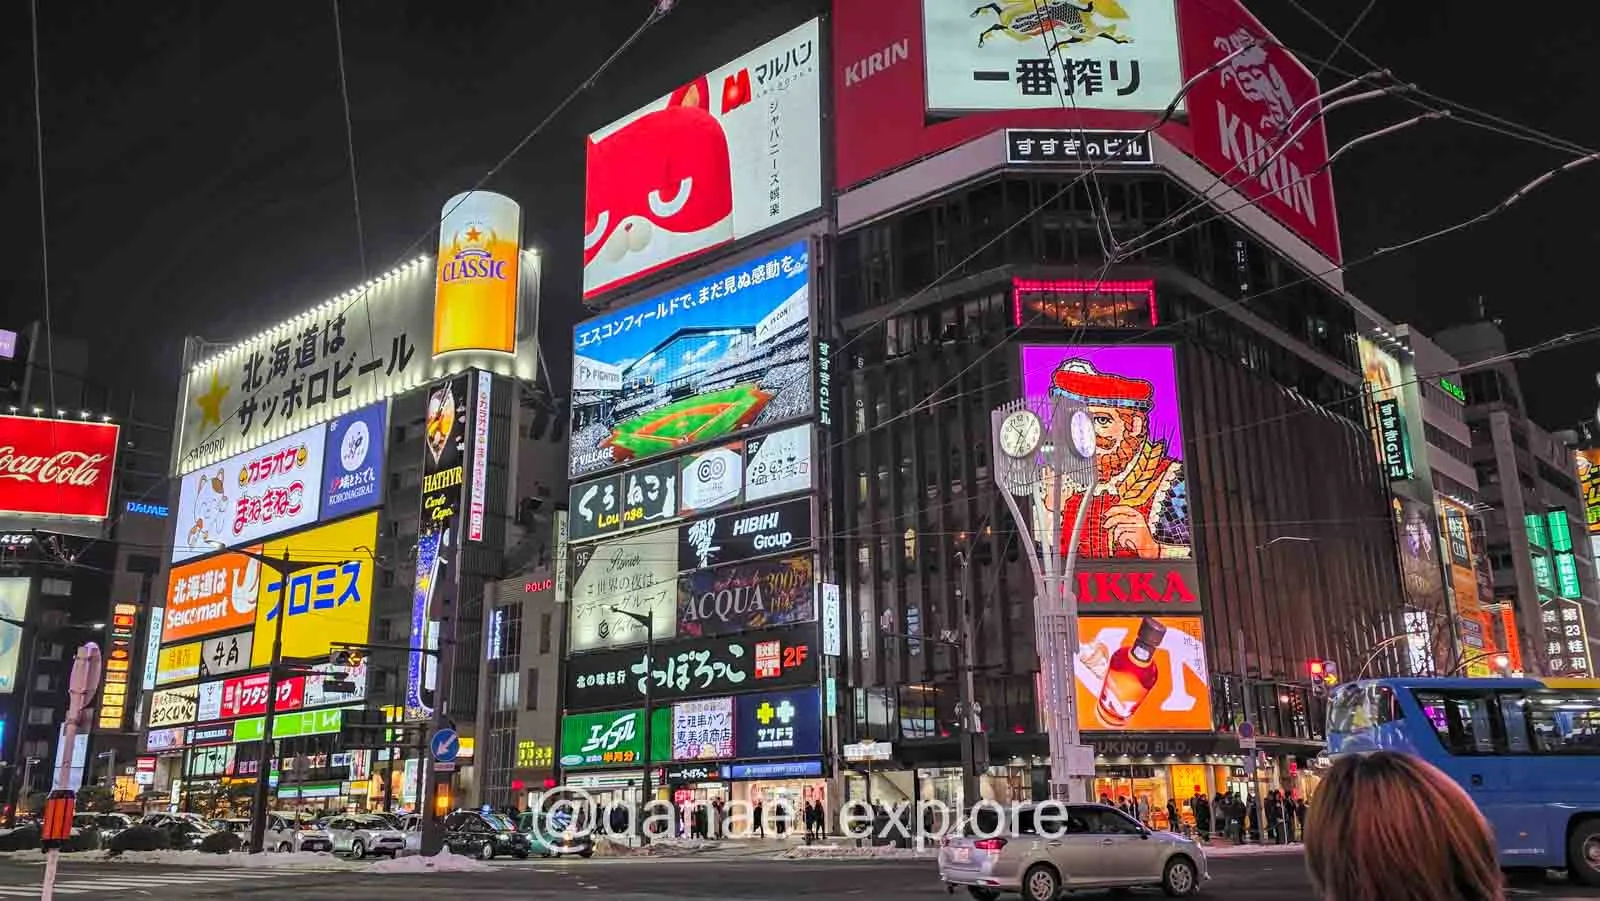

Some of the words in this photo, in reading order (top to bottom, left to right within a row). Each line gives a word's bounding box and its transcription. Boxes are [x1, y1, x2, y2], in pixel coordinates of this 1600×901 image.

[754, 39, 813, 86] マルハン
[844, 38, 910, 88] KIRIN
[973, 57, 1141, 97] 一番搾り
[1016, 138, 1144, 158] すすきのビル
[1216, 100, 1318, 227] KIRIN
[442, 258, 508, 283] CLASSIC
[240, 313, 347, 394] 北海道は
[238, 332, 415, 437] サッポロビール
[1380, 402, 1404, 478] すすきのビル
[246, 445, 299, 484] カラオケ
[423, 466, 463, 494] HATHYR
[231, 480, 305, 536] まねきねこ
[578, 473, 661, 522] くろねこ
[597, 504, 644, 529] Lounge
[732, 511, 780, 537] HIBIKI
[753, 530, 793, 551] Group
[173, 567, 228, 605] 北海道は
[266, 562, 361, 621] プロミス
[681, 585, 765, 622] ACQUA
[1059, 570, 1197, 604] IKKA
[166, 599, 228, 629] Seicomart
[213, 637, 239, 666] 牛角
[631, 644, 746, 694] さっぽろっこ
[783, 645, 809, 668] 2F
[581, 713, 637, 752] エイブル
